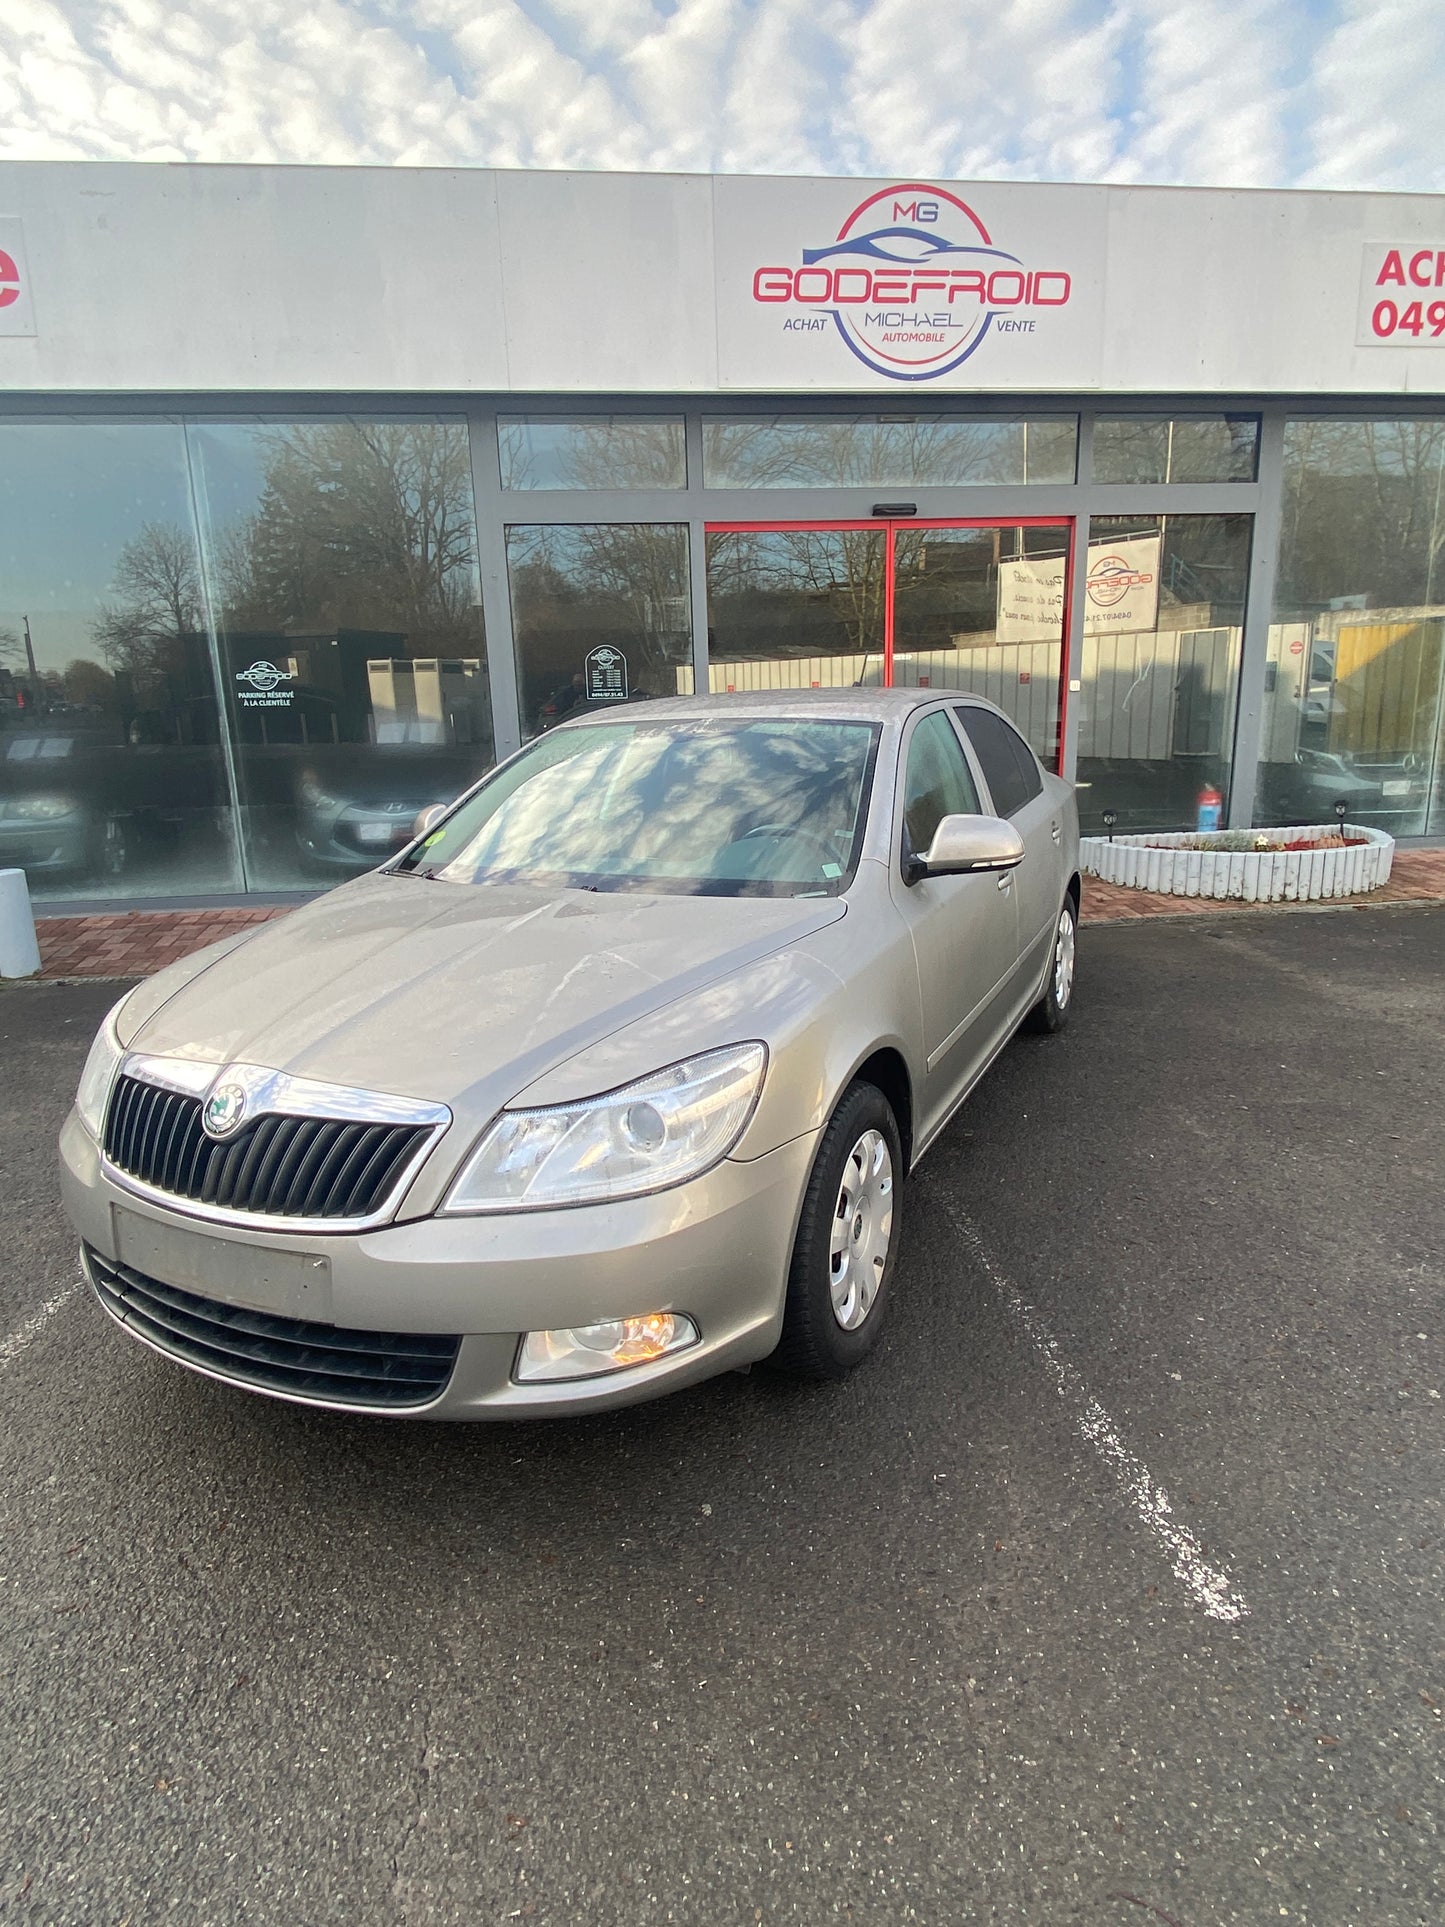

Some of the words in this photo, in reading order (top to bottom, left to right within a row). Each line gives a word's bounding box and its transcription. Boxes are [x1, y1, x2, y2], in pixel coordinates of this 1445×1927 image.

[893, 201, 939, 223] MG
[752, 266, 1072, 306] GODEFROID
[783, 318, 828, 332] ACHAT
[864, 312, 964, 328] MICHAEL
[996, 320, 1036, 333] VENTE
[1371, 299, 1445, 338] 049
[881, 333, 946, 343] AUTOMOBILE
